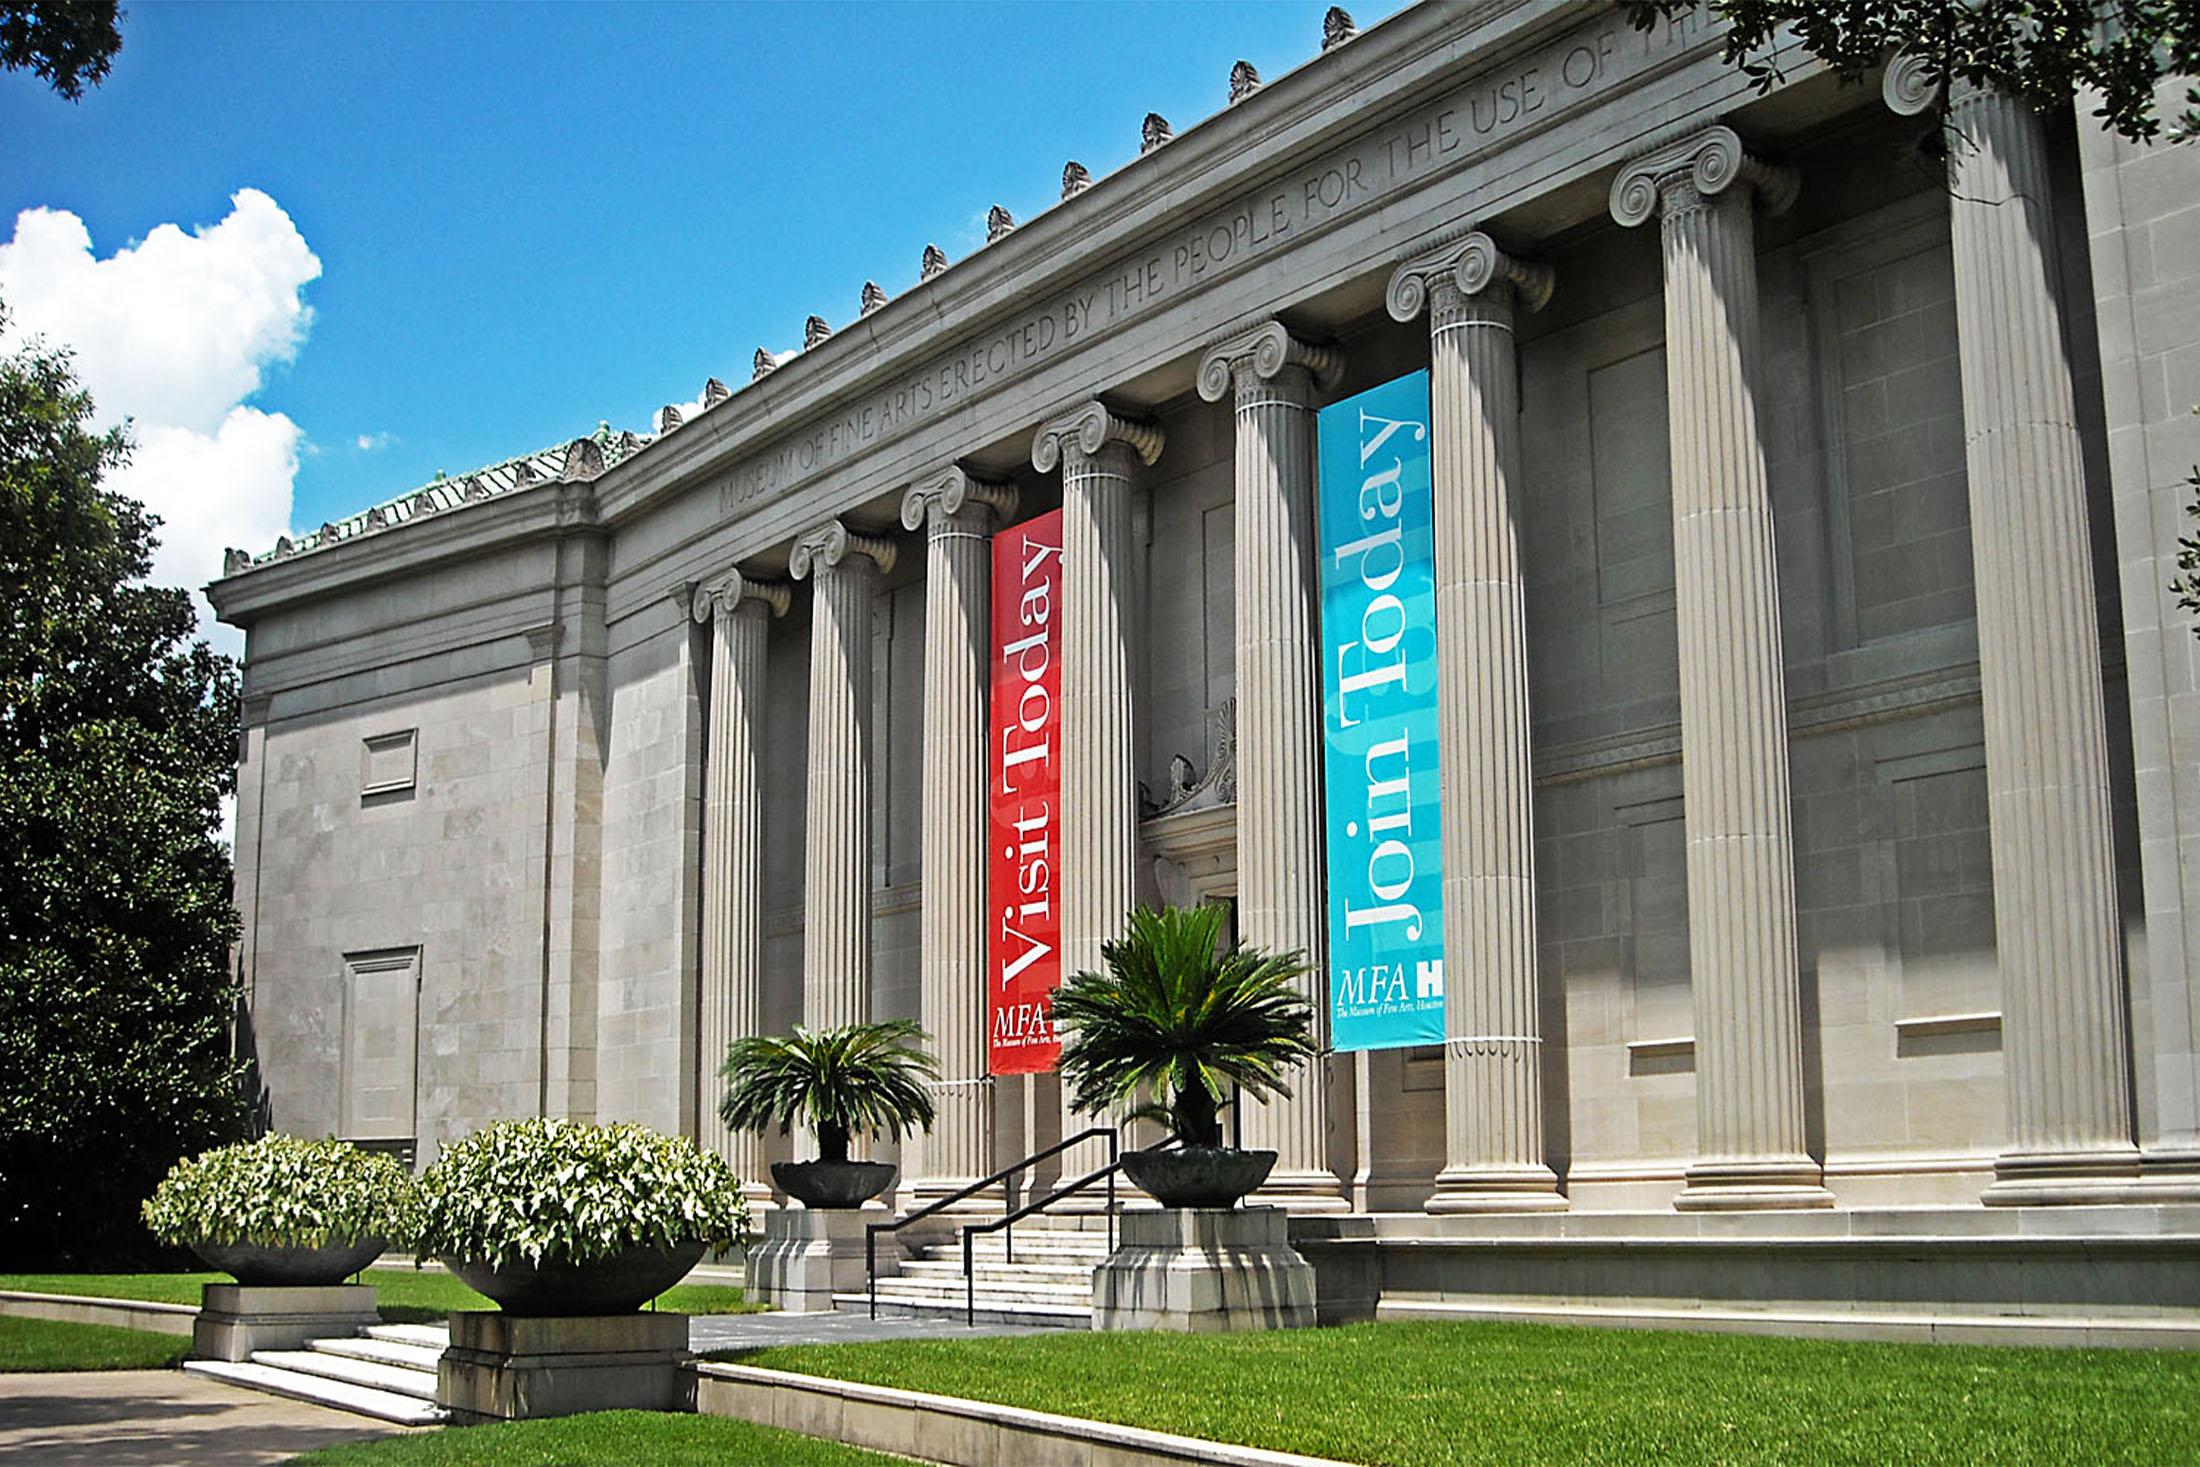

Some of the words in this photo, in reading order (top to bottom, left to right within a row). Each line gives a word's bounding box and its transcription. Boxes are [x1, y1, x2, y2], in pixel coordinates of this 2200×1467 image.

[718, 452, 793, 514] MUSEUM
[799, 432, 825, 470] OF
[829, 406, 873, 457] FINE
[880, 377, 933, 432] ARTS
[940, 315, 1056, 401] ERECTED
[1064, 293, 1094, 340] BY
[1103, 260, 1164, 315] THE
[1174, 194, 1291, 283] PEOPLE
[1304, 158, 1369, 220] FOR
[1377, 110, 1460, 179] THE
[1471, 68, 1545, 134] USE
[1563, 30, 1615, 89] OF
[1001, 533, 1064, 795] Today
[1334, 406, 1426, 728] Today
[1001, 801, 1053, 992] Visit
[1345, 727, 1423, 942] Join
